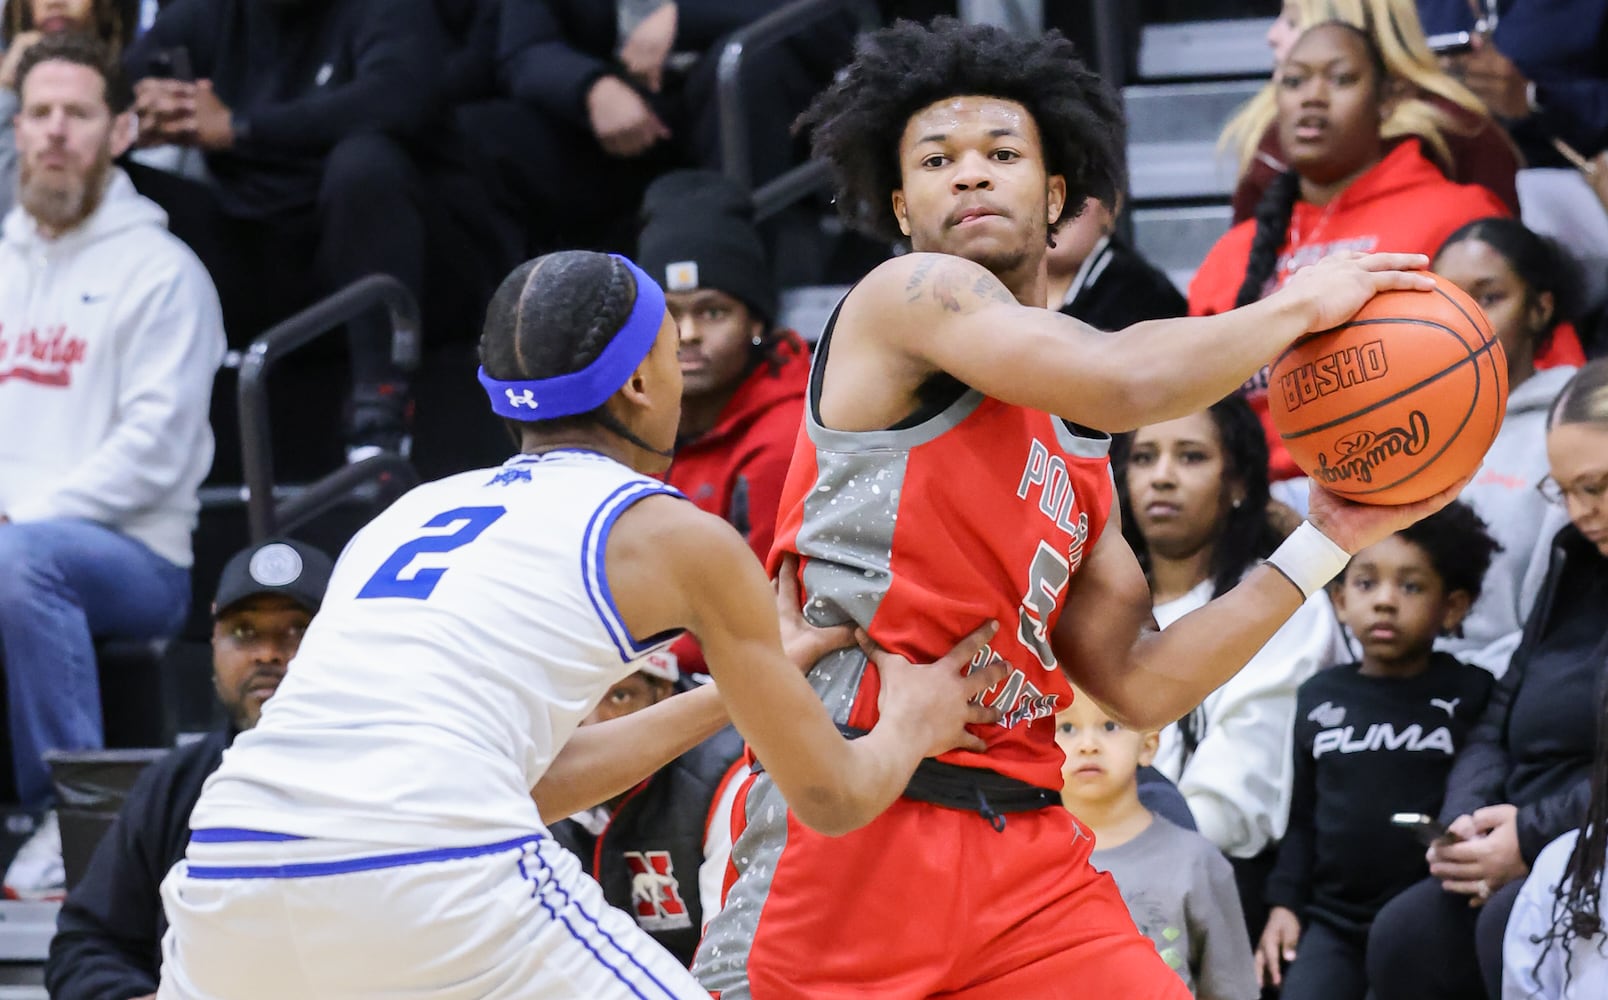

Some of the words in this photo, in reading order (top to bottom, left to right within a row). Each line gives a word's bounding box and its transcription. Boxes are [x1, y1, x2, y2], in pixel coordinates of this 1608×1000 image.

[1280, 339, 1389, 413] OHSAA
[1312, 409, 1430, 484] Rawlings
[354, 505, 508, 601] 2
[1016, 538, 1070, 672] 5
[1312, 722, 1455, 760] PUMA
